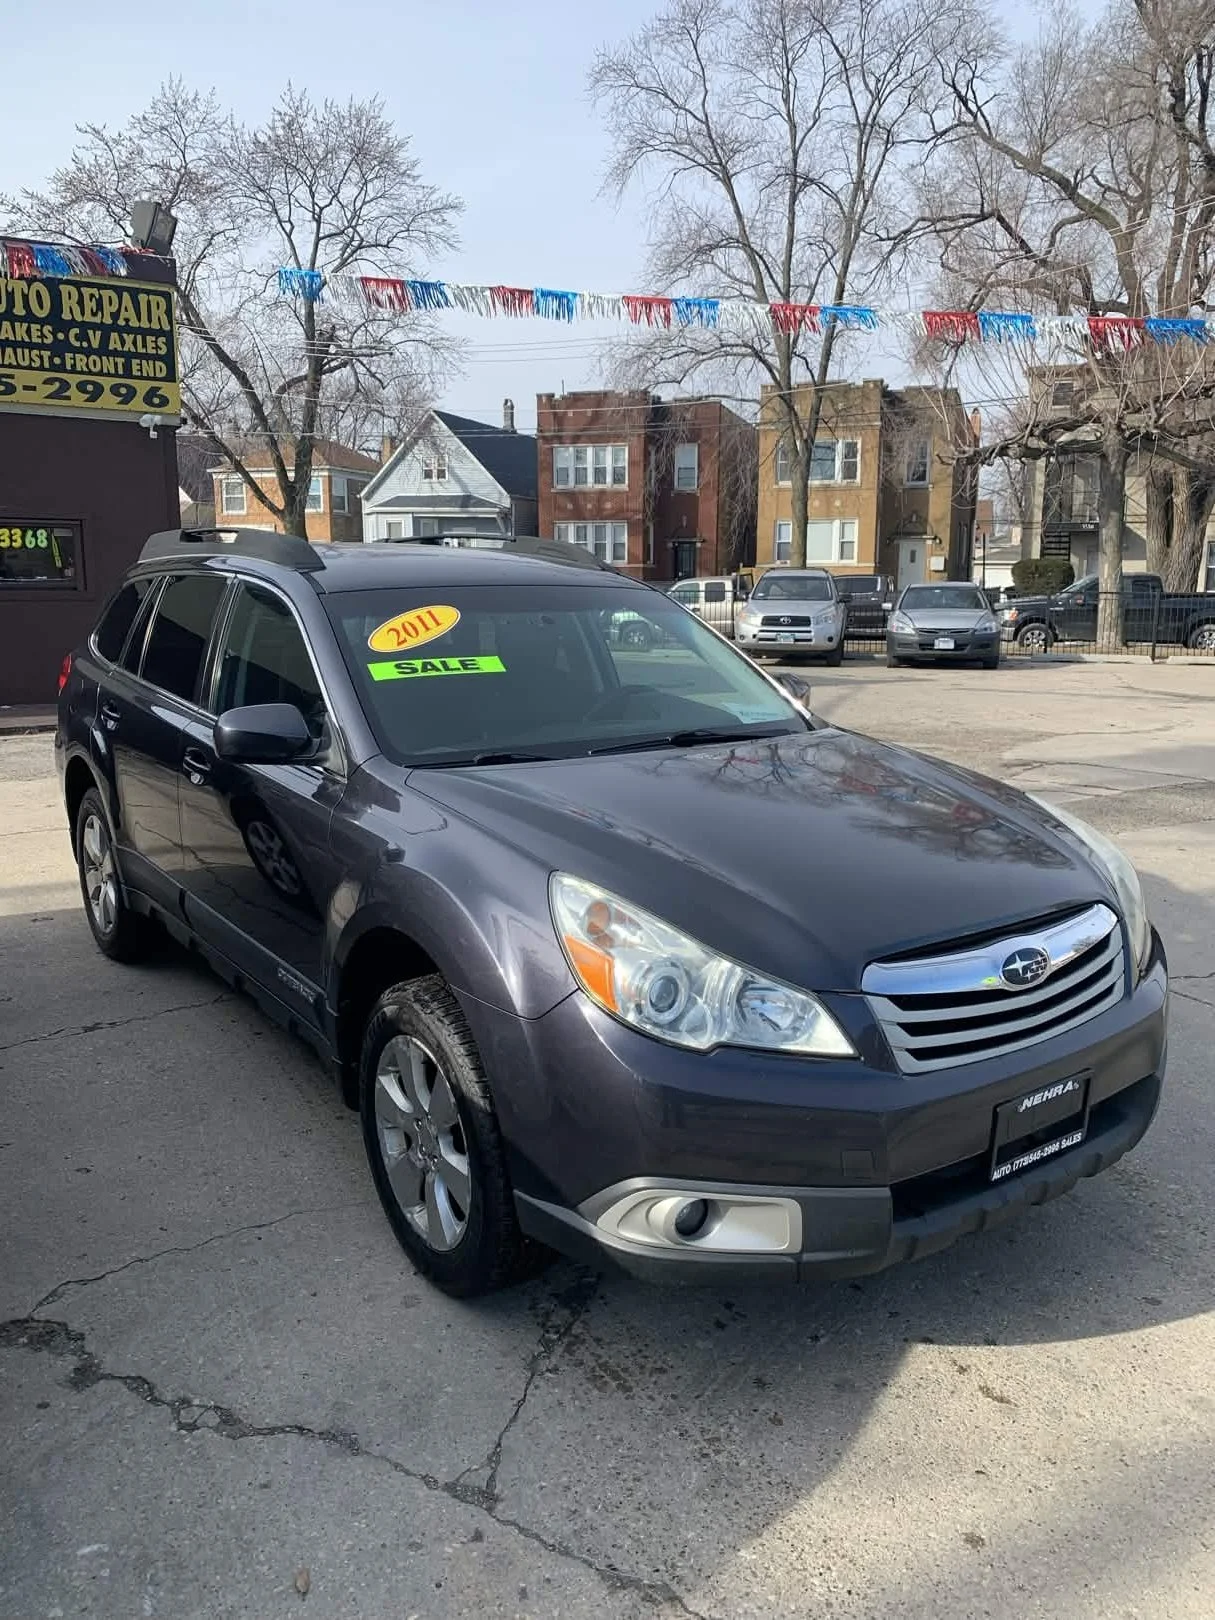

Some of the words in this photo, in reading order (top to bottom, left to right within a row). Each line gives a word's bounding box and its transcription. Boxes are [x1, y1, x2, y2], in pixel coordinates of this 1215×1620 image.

[59, 284, 170, 331] REPAIR
[68, 328, 101, 349] C.V
[108, 332, 168, 355] AXLES
[0, 347, 51, 369] AUST
[65, 353, 125, 376] FRONT
[131, 359, 167, 377] END
[387, 609, 443, 647] 2011
[394, 658, 480, 675] SALE
[1019, 1080, 1075, 1113] NEHRA
[991, 1164, 1012, 1182] AUTO
[1060, 1131, 1083, 1150] SALES
